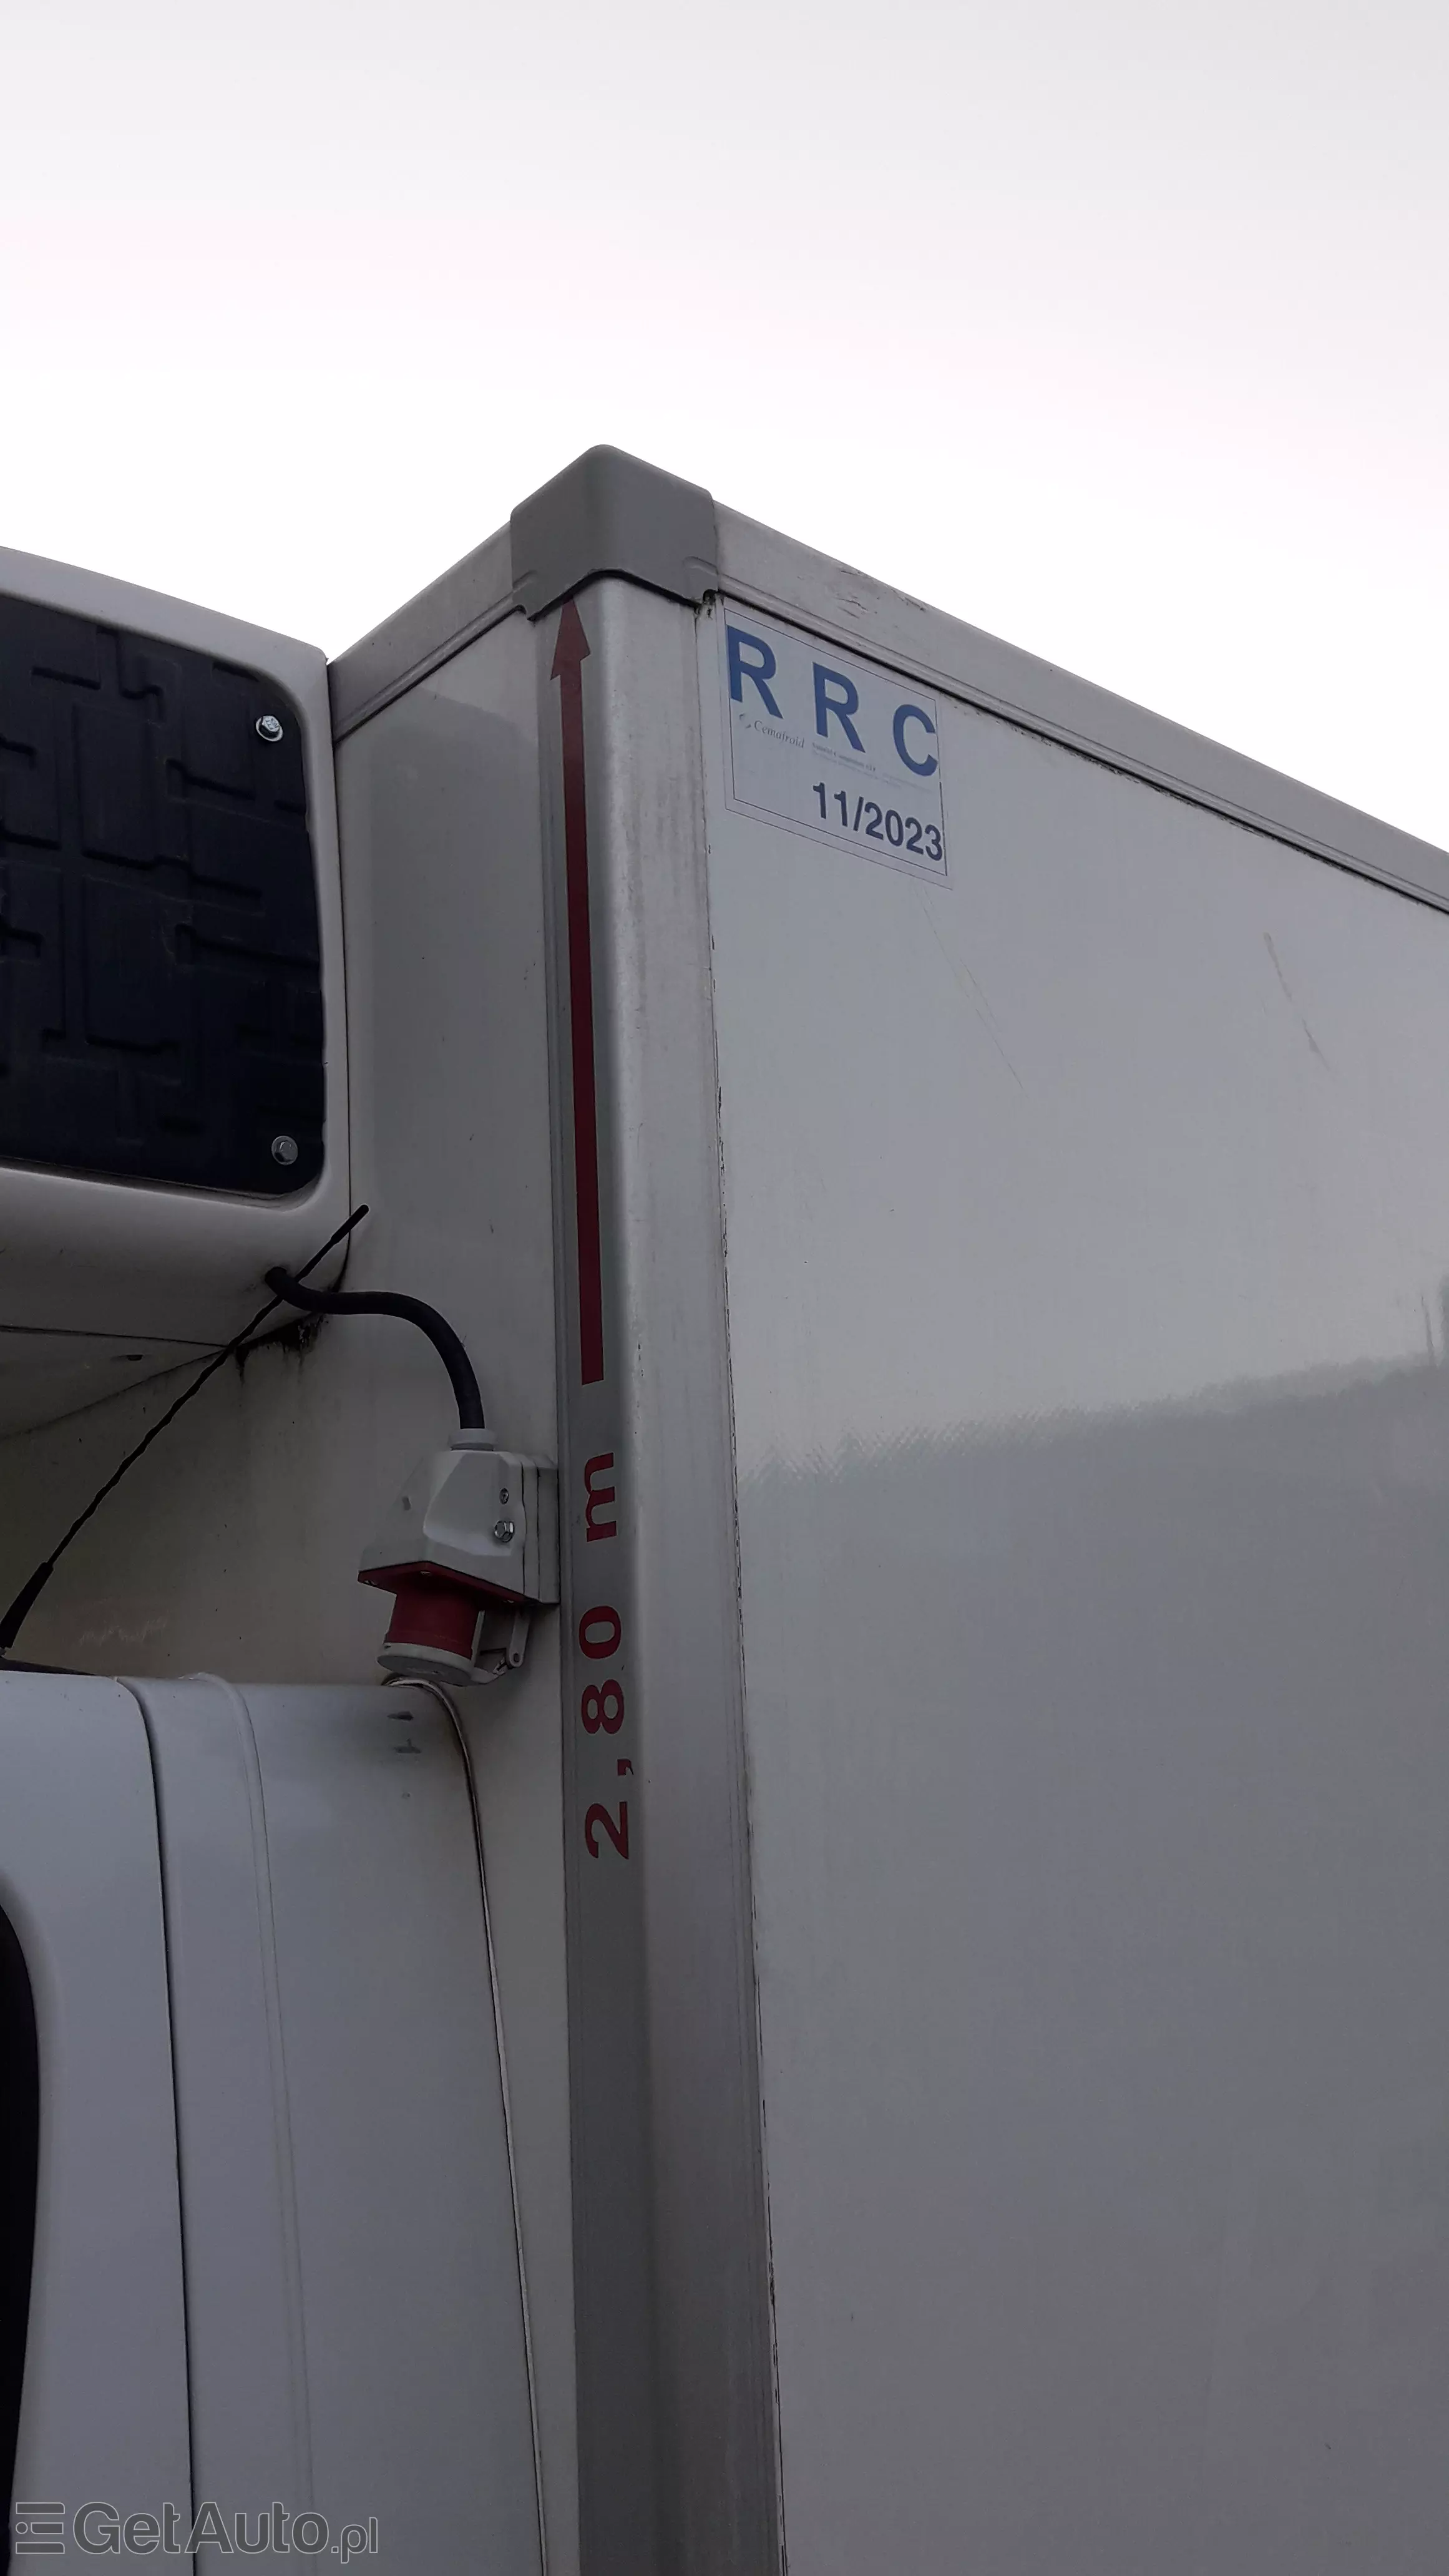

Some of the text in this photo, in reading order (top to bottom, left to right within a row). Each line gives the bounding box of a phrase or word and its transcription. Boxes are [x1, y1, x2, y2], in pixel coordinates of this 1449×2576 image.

[754, 720, 805, 748] Cemafroid
[812, 782, 943, 861] 11/2023
[578, 1451, 634, 1860] 2,80 m
